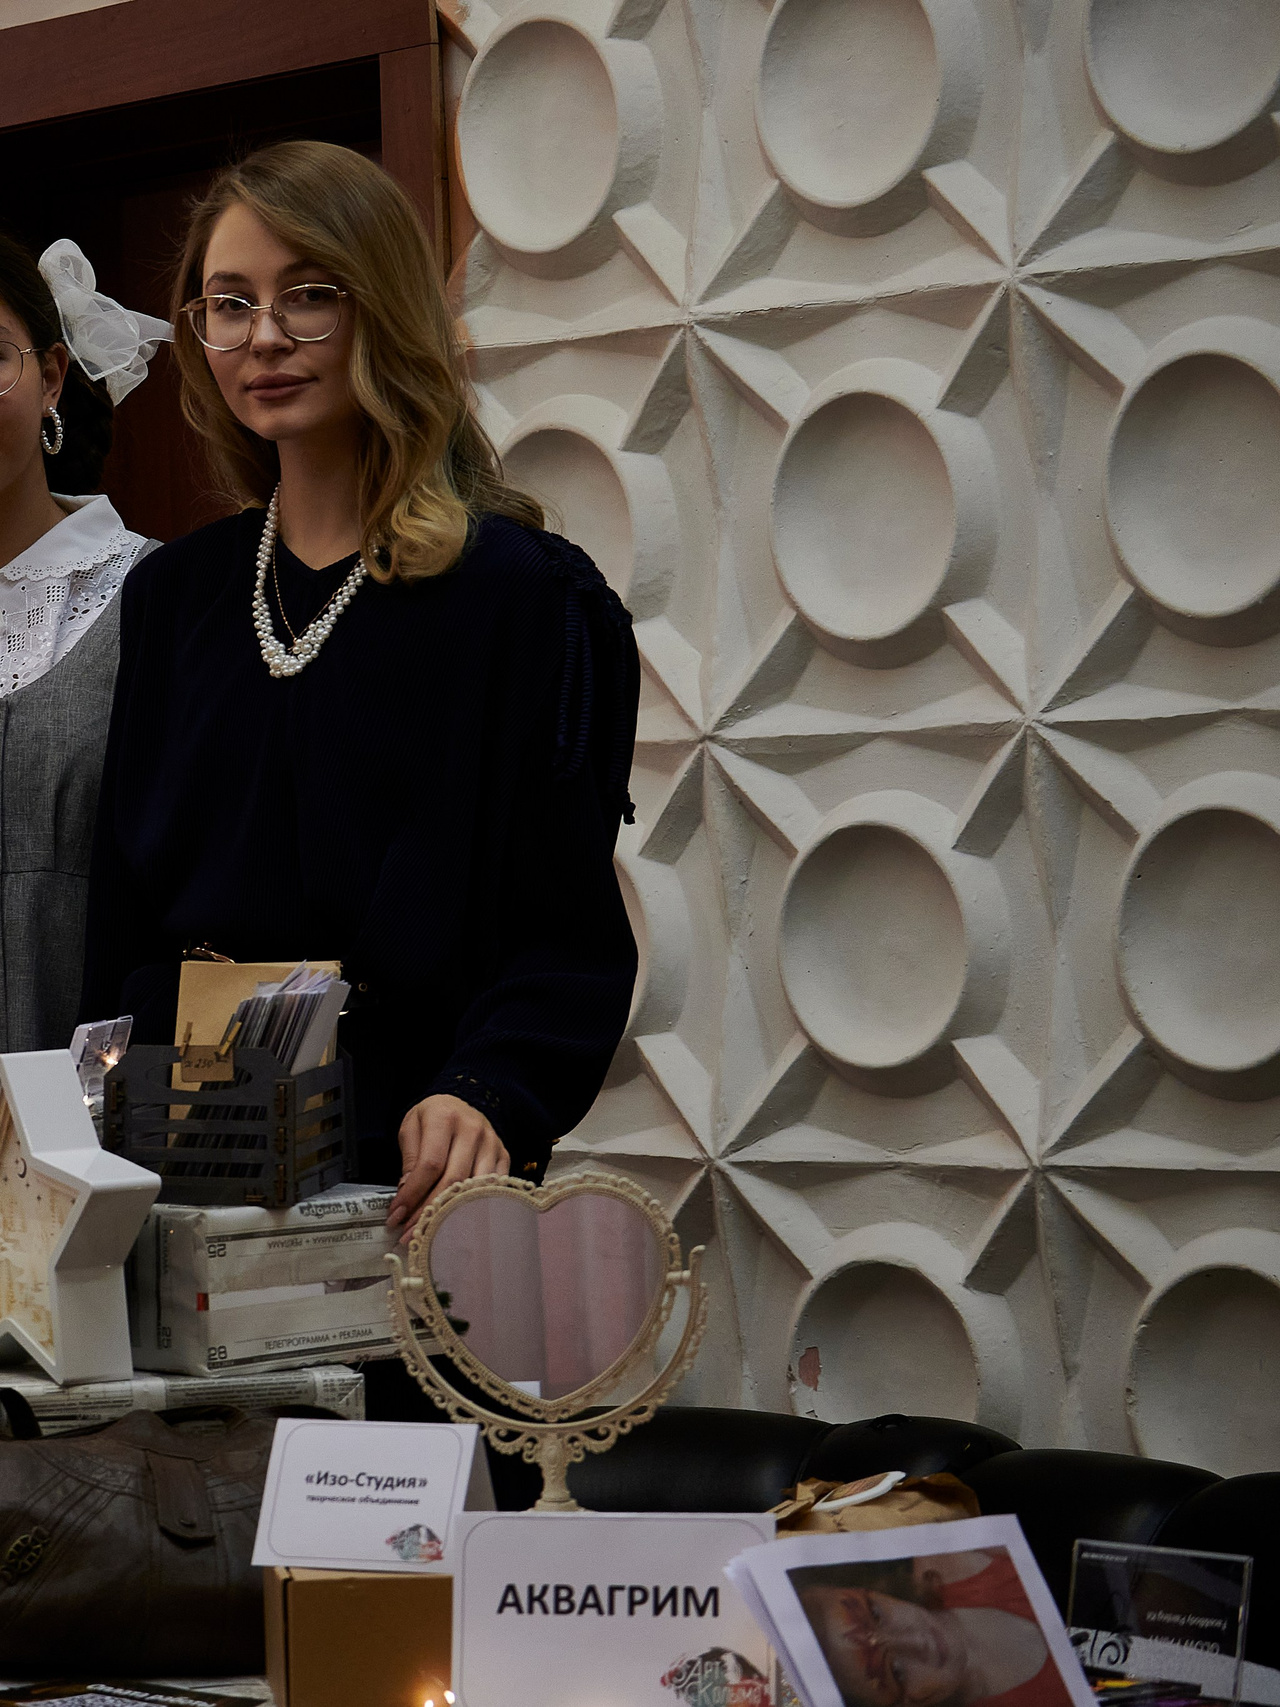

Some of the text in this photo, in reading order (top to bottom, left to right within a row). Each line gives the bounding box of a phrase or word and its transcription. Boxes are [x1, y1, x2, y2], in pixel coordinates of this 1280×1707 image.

[266, 1236, 304, 1249] РЕКЛАМА
[312, 1230, 373, 1245] ТЕЛЕПРОГРАММА
[206, 1243, 227, 1258] 25
[264, 1334, 330, 1351] ТЕЛЕПРОГРАММА
[338, 1327, 374, 1341] РЕКЛАМА
[207, 1345, 228, 1361] 28
[305, 1470, 428, 1491] «Изо-Студия»
[306, 1494, 420, 1506] творческое объединение
[497, 1583, 719, 1619] АКВАГРИМ
